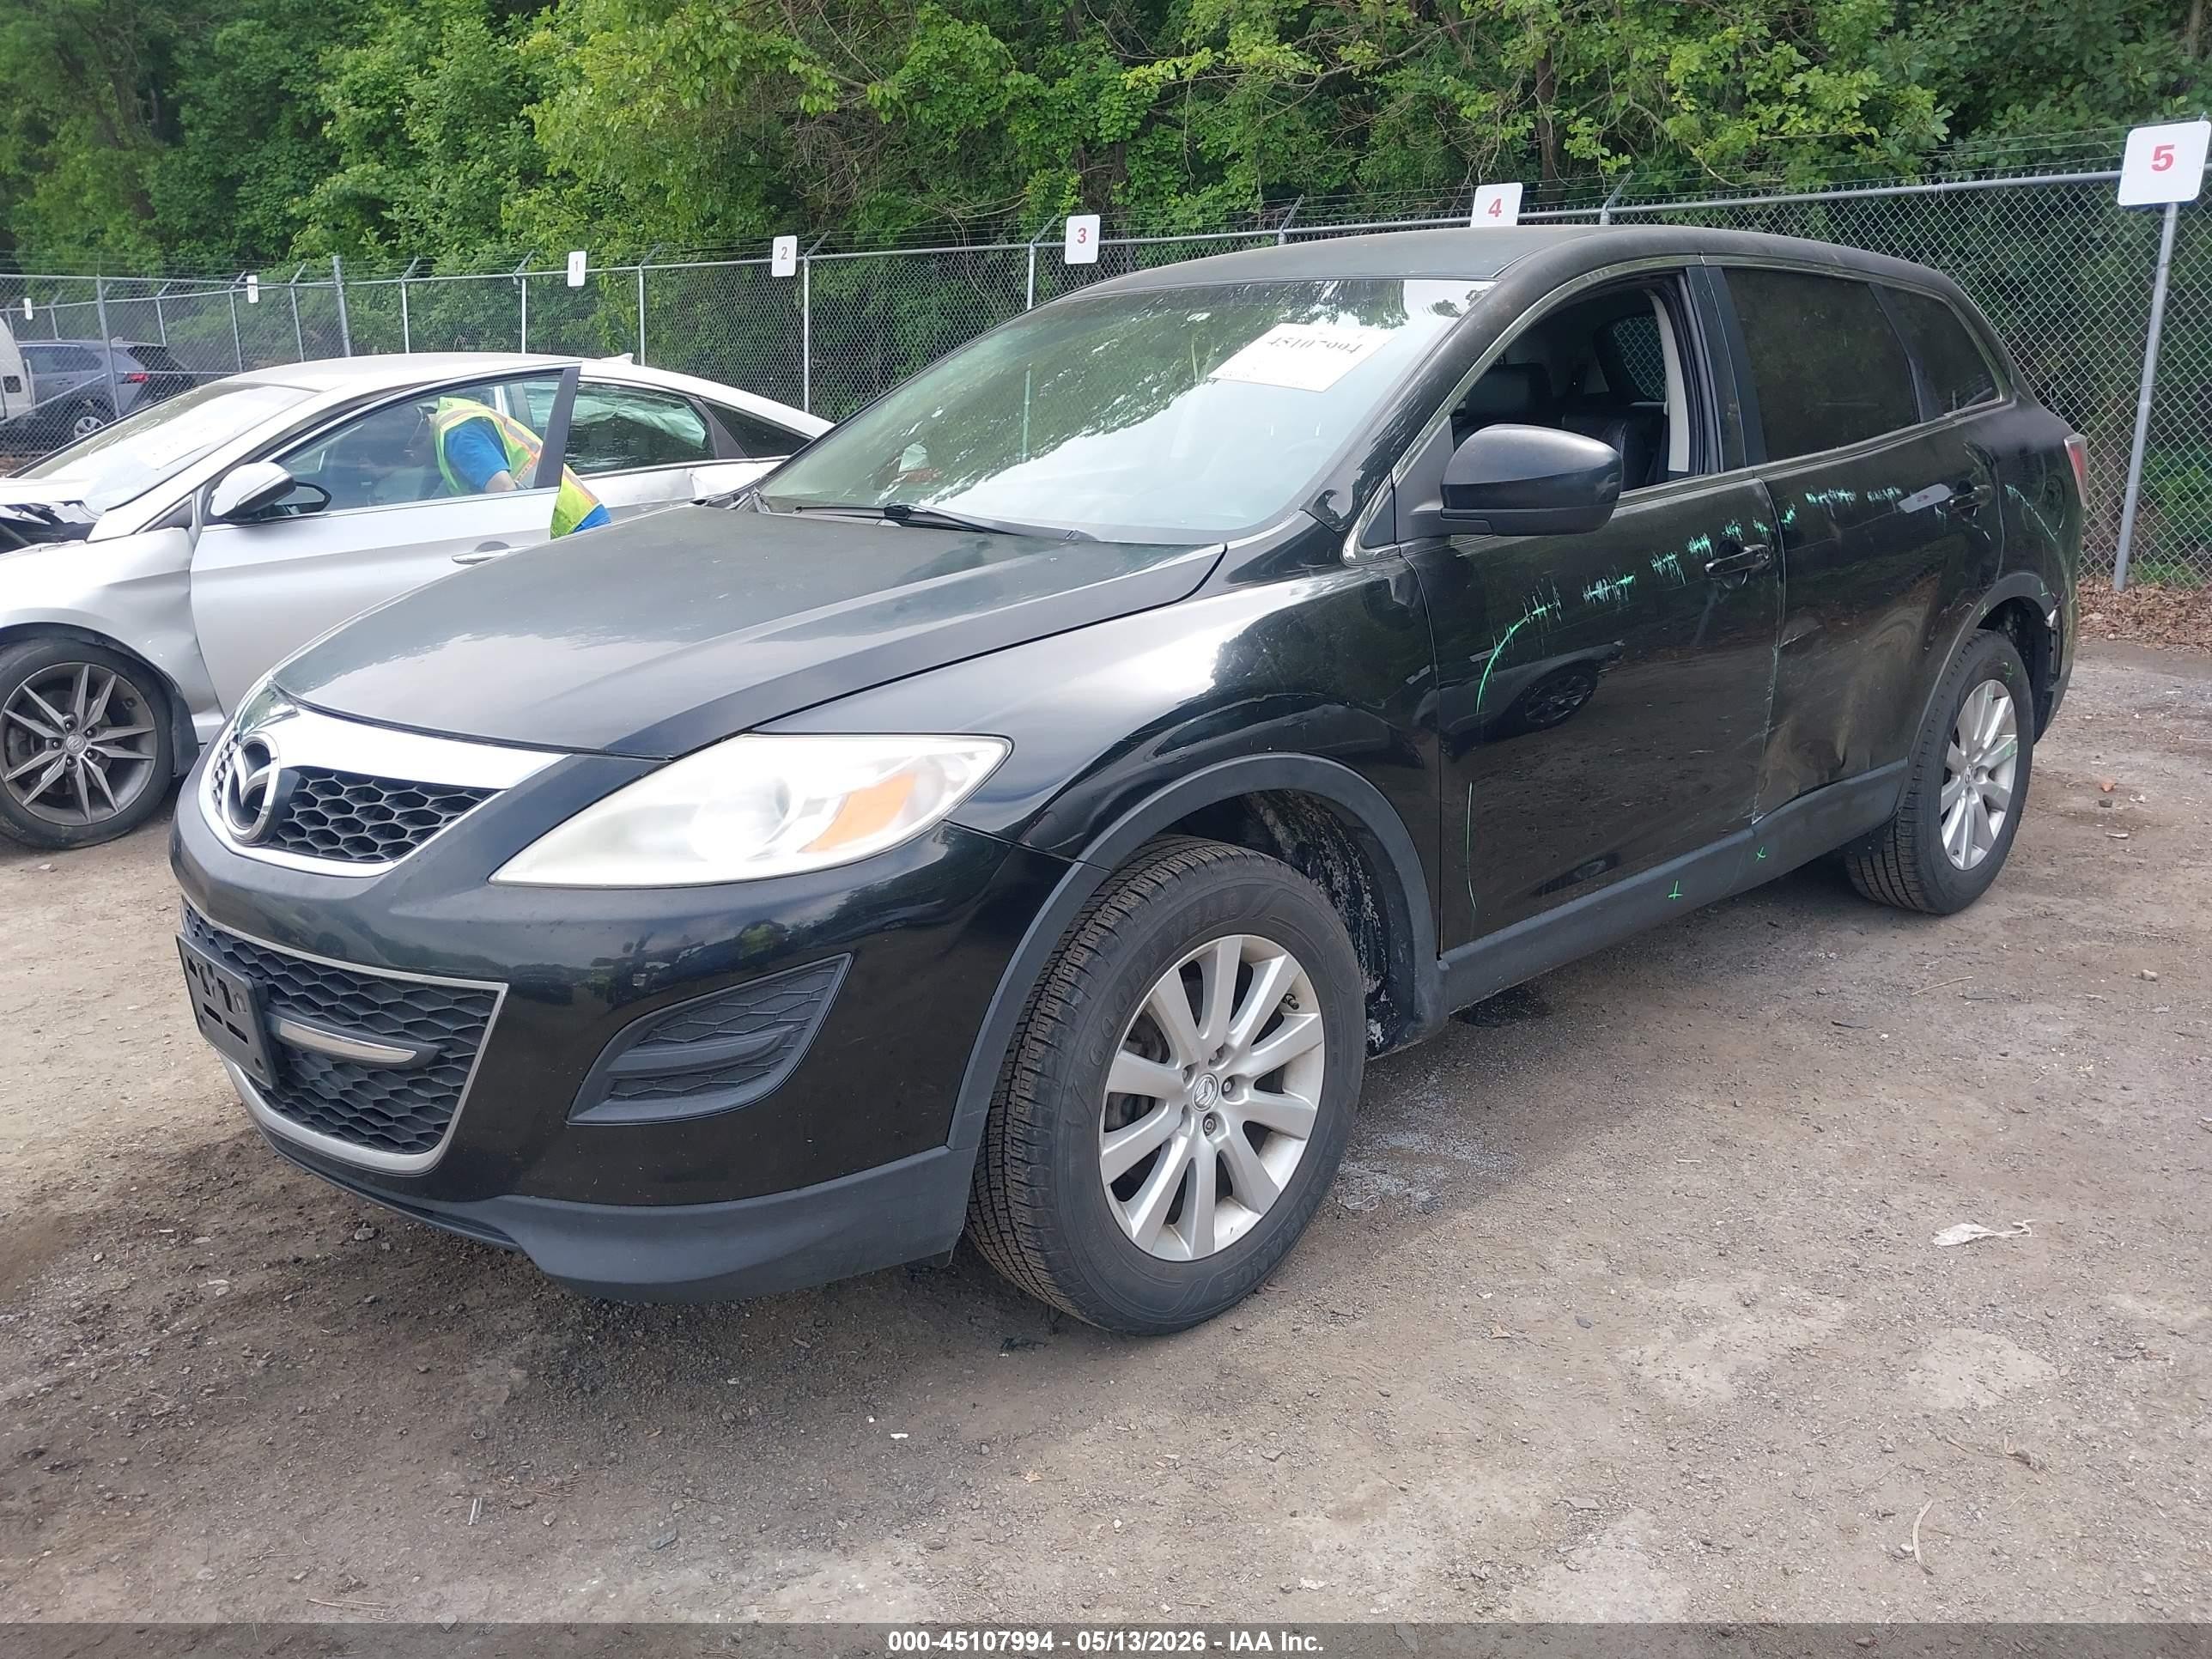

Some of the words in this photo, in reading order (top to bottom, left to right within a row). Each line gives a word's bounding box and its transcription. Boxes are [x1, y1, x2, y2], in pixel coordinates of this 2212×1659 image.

[2151, 143, 2175, 172] 5
[1487, 198, 1503, 218] 4
[1077, 228, 1087, 244] 3
[780, 246, 788, 260] 2
